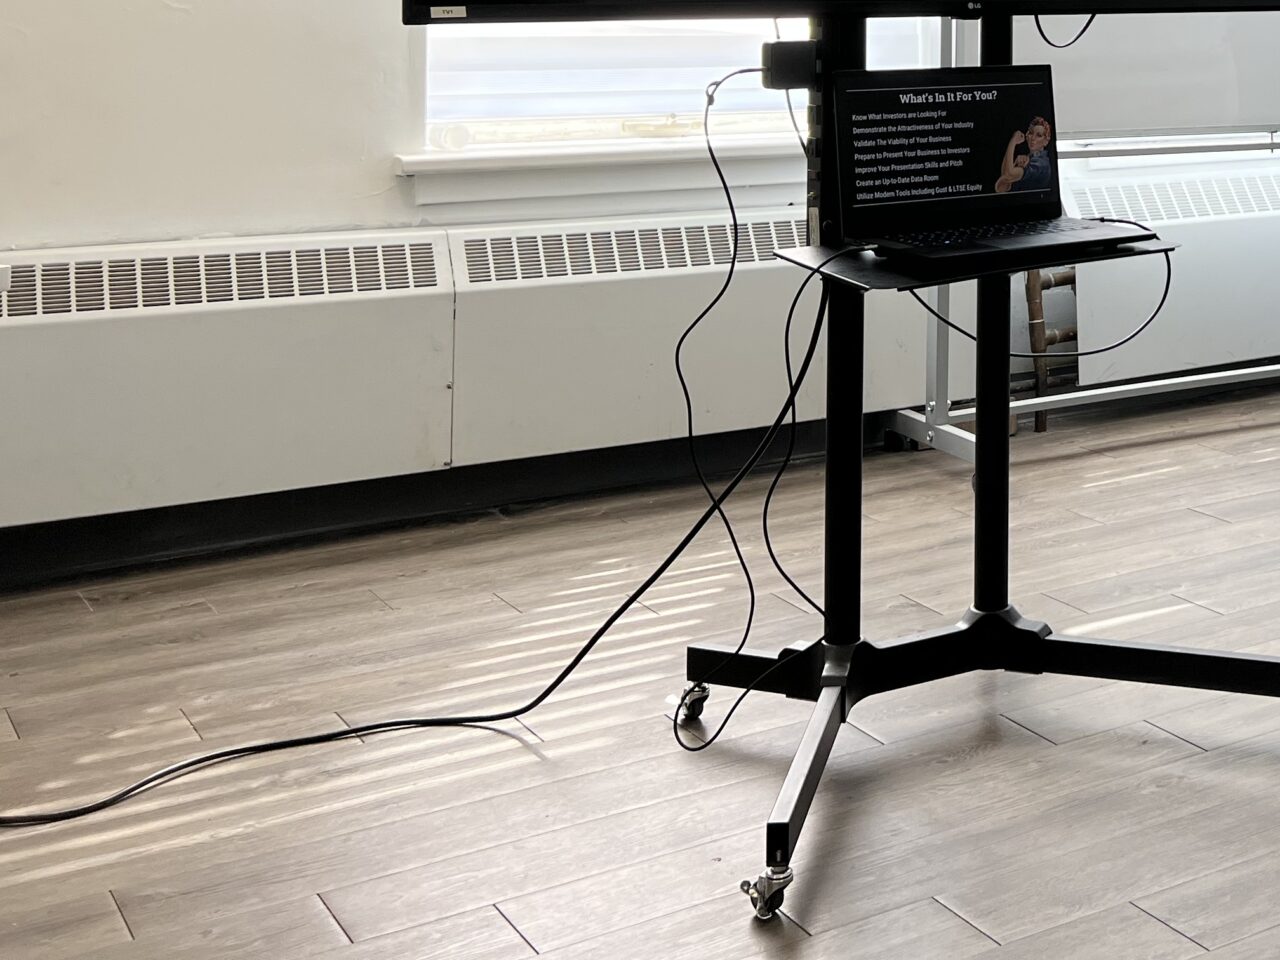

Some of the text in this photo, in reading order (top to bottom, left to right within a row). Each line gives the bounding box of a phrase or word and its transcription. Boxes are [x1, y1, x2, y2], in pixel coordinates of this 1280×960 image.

[934, 92, 946, 102] In
[946, 92, 955, 102] It
[956, 91, 973, 101] For
[973, 90, 997, 101] You?
